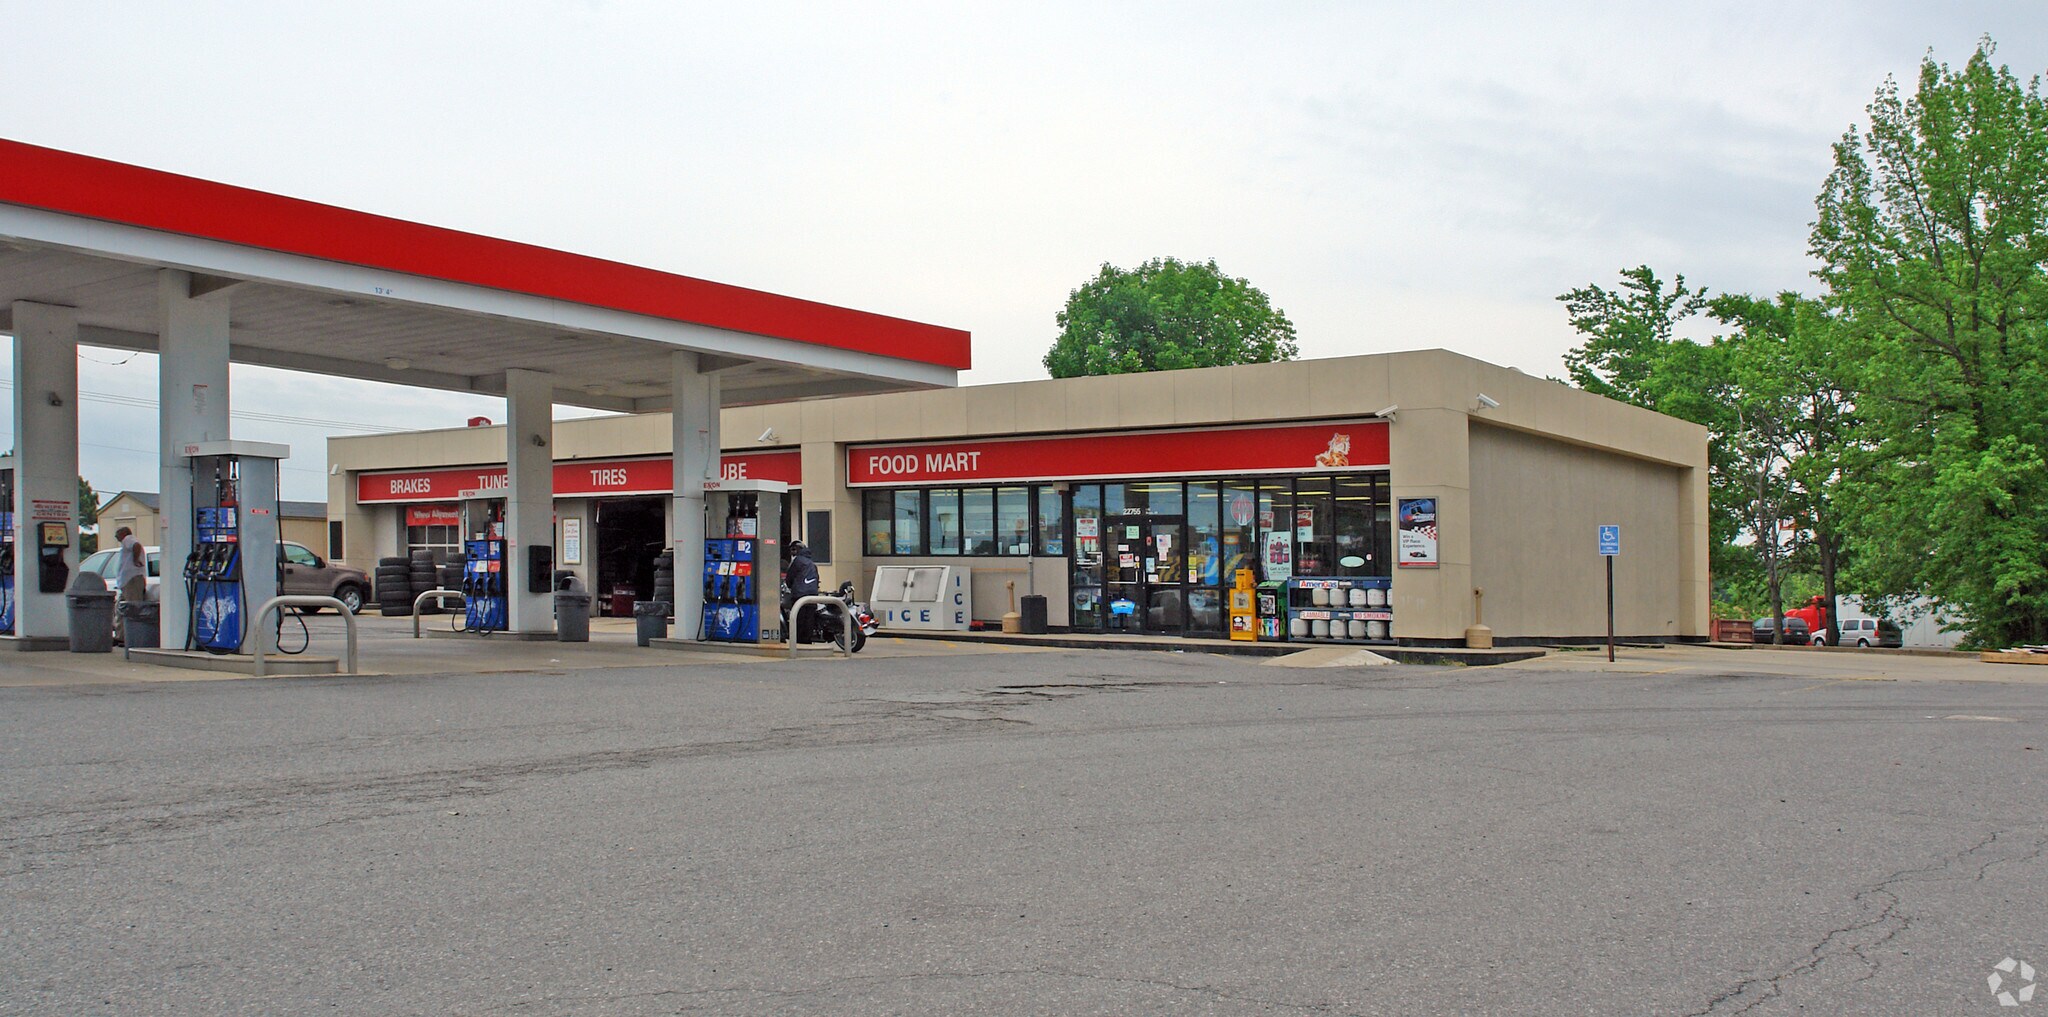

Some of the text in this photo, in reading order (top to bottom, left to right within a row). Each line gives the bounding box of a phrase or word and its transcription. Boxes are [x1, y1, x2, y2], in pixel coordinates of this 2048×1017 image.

[720, 462, 748, 480] UBE
[869, 451, 981, 475] FOOD MART
[390, 474, 508, 494] BRAKES TUNE
[590, 468, 627, 486] TIRES
[1123, 507, 1141, 515] 22755
[745, 541, 751, 554] 2
[1301, 580, 1337, 589] AmeriGas
[954, 575, 964, 624] ICE
[888, 609, 931, 623] ICE
[1354, 611, 1362, 619] NO
